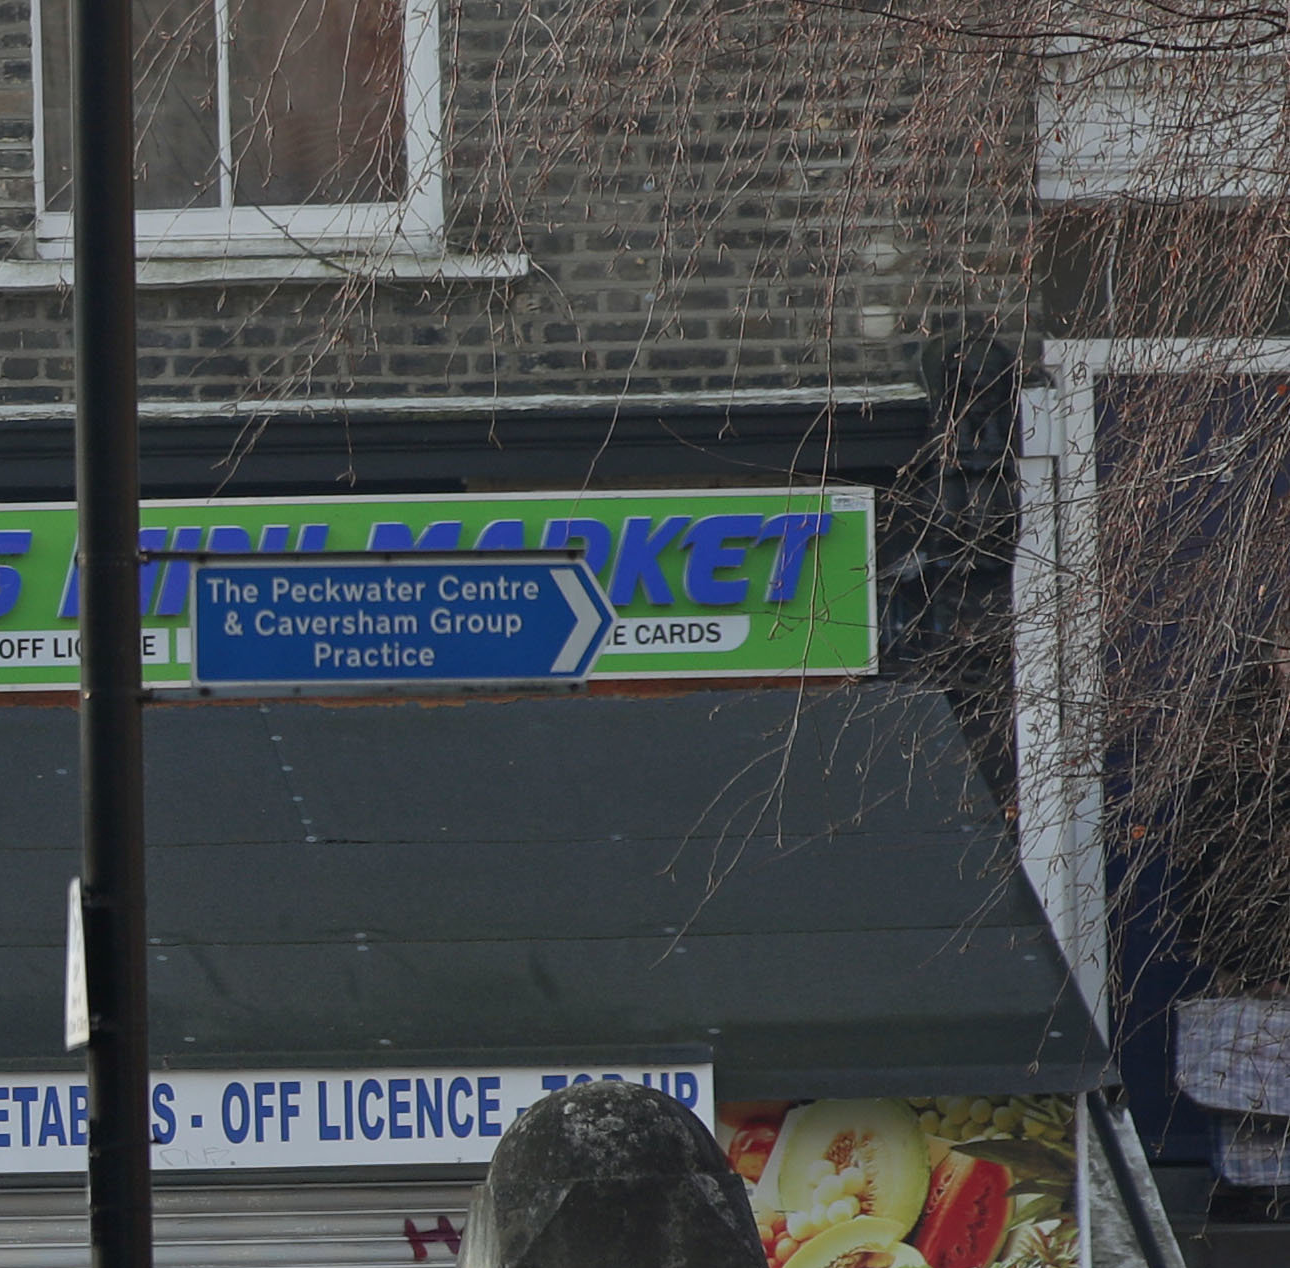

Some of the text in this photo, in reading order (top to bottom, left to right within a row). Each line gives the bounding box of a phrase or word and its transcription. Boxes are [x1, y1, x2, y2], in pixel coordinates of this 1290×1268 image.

[206, 574, 540, 604] The Peckwater Centre
[224, 608, 523, 639] & Caversham Group
[634, 622, 722, 646] CARDS
[313, 641, 435, 669] Practice
[221, 1080, 301, 1144] OFF
[318, 1074, 502, 1141] LICENCE
